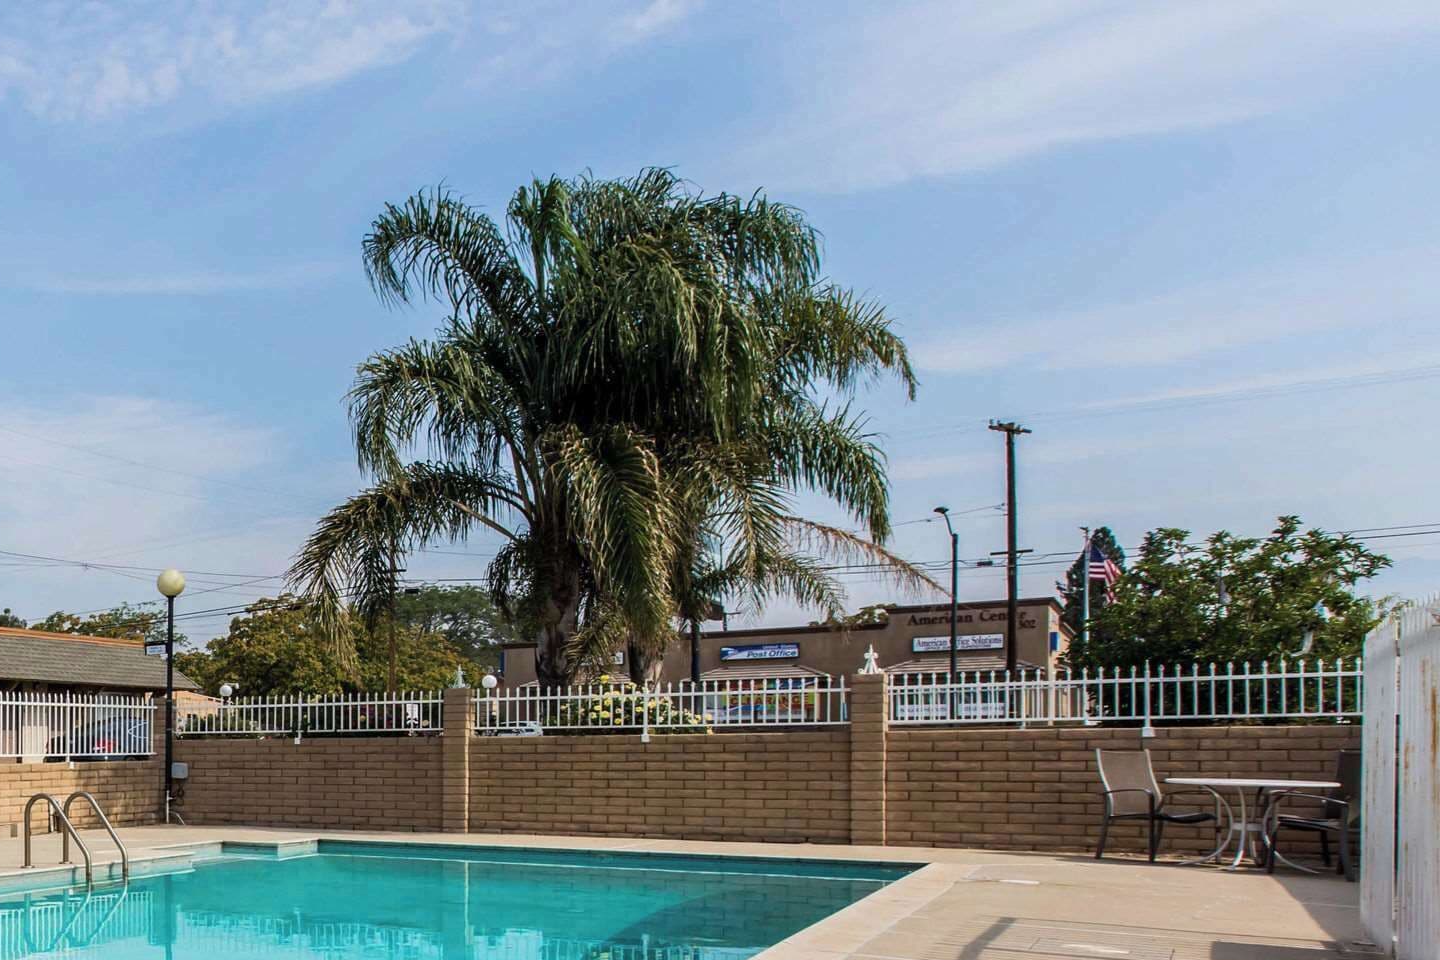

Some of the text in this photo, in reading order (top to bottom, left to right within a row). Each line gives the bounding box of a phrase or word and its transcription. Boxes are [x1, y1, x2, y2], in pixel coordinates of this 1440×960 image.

[907, 611, 1027, 625] Amerian Cenr
[916, 638, 947, 647] American
[971, 634, 1002, 644] Solutions
[768, 648, 797, 657] Office
